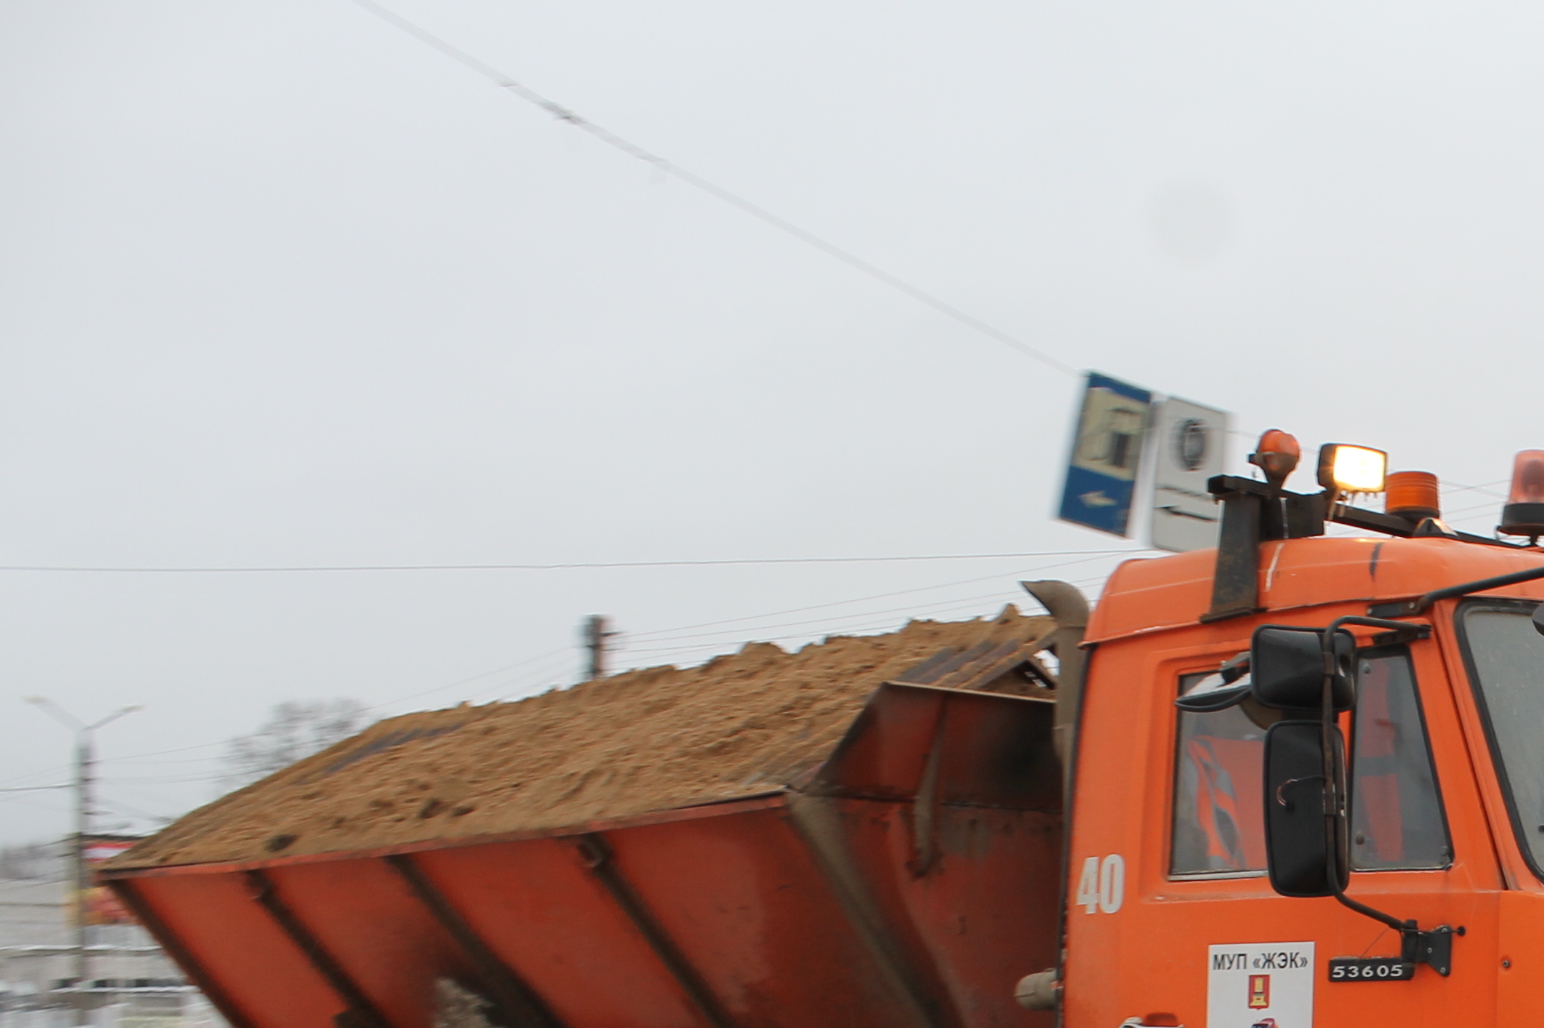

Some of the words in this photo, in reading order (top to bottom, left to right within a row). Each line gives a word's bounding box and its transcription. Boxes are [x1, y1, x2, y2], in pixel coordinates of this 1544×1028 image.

[1076, 853, 1126, 915] 40
[1212, 953, 1248, 971] МУП
[1252, 952, 1308, 969] «ЖЭК»
[1332, 965, 1403, 978] 53605
